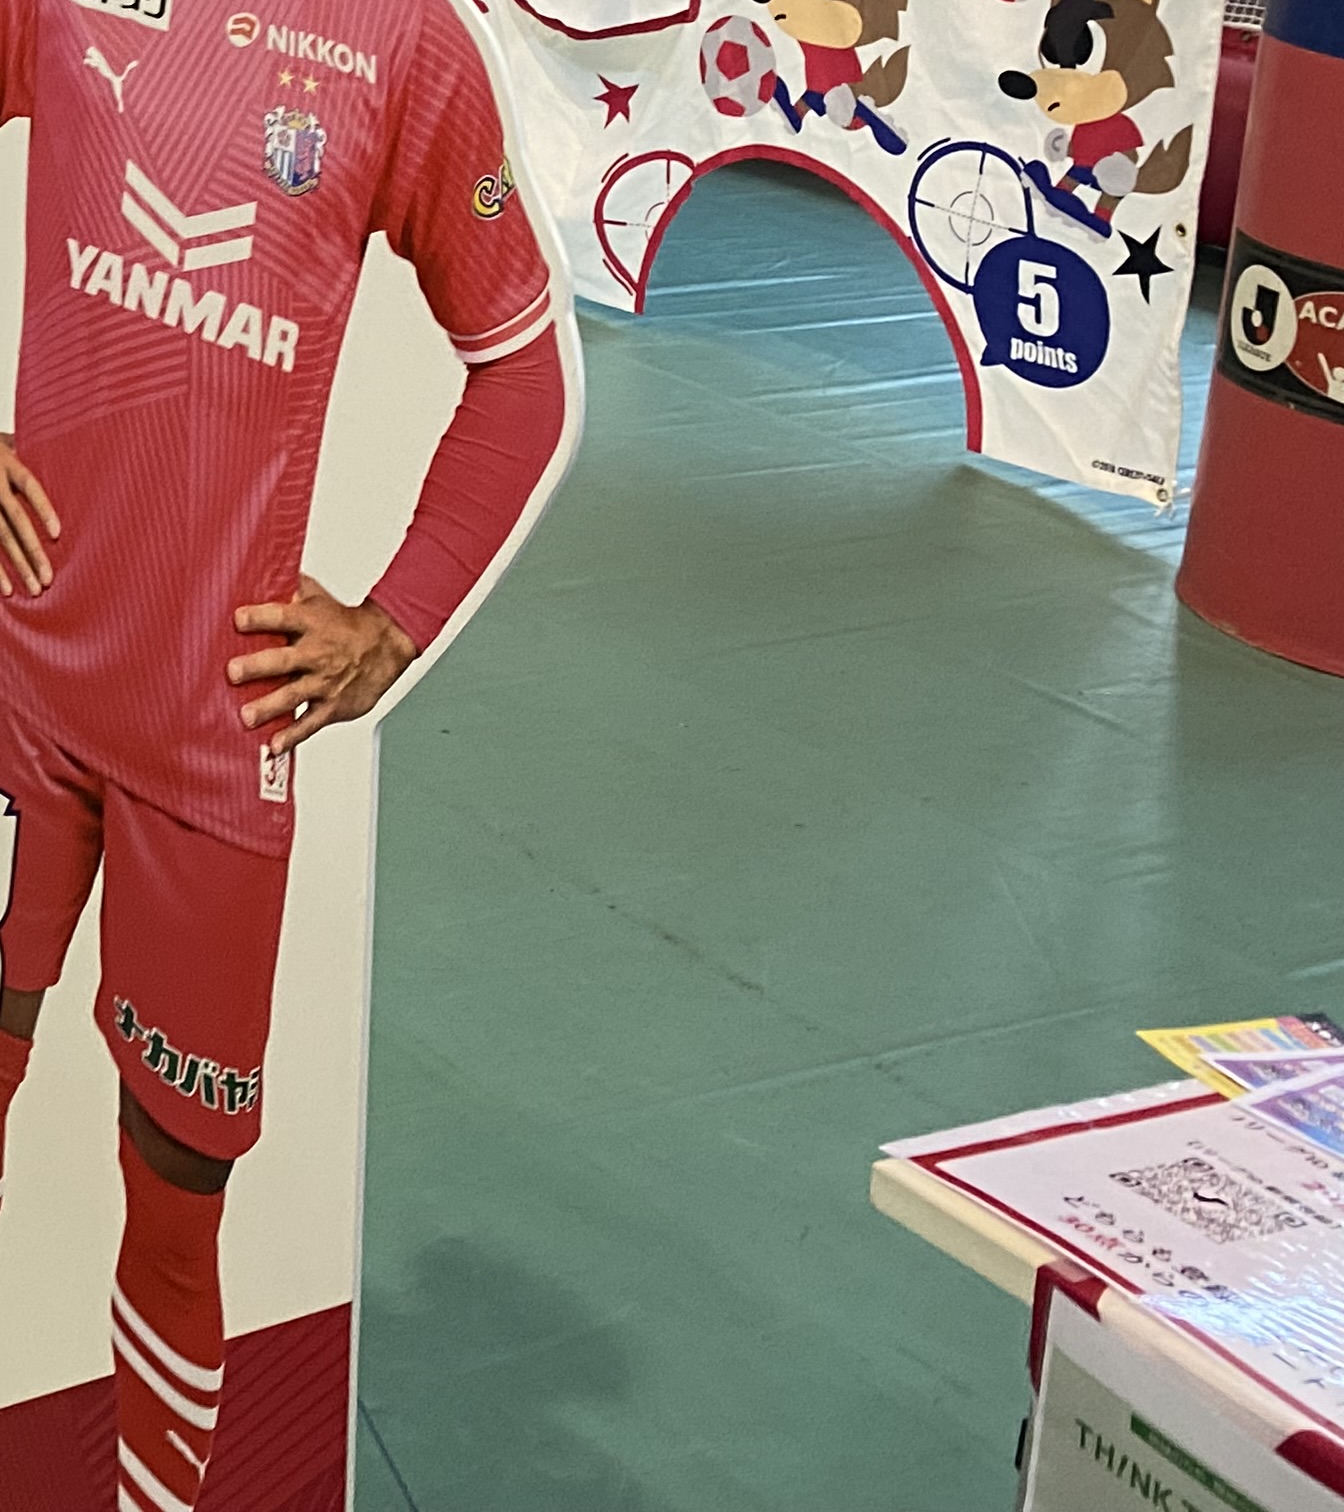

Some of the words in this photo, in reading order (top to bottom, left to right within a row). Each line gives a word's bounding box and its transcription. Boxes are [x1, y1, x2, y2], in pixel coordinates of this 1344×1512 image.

[267, 24, 376, 85] NIKKON
[66, 238, 299, 373] YANMAR
[1017, 259, 1060, 337] 5
[1010, 337, 1078, 374] points
[1075, 1418, 1173, 1512] THINK
